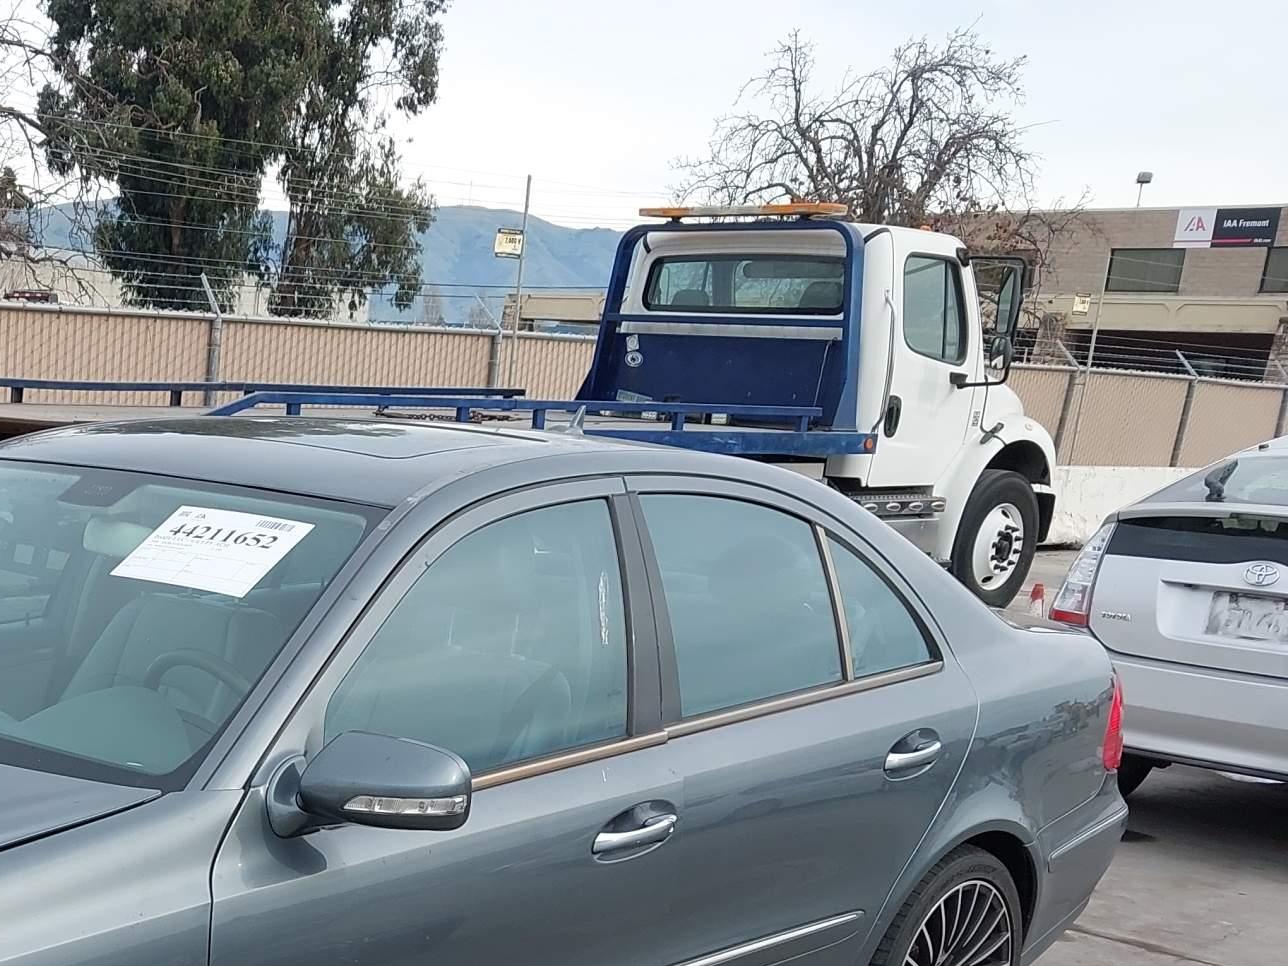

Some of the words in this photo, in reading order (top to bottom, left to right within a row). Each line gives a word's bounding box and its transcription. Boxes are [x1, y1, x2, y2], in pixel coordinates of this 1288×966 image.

[1224, 219, 1238, 228] IAA
[1238, 219, 1270, 228] Fremont
[169, 523, 279, 549] 44211652
